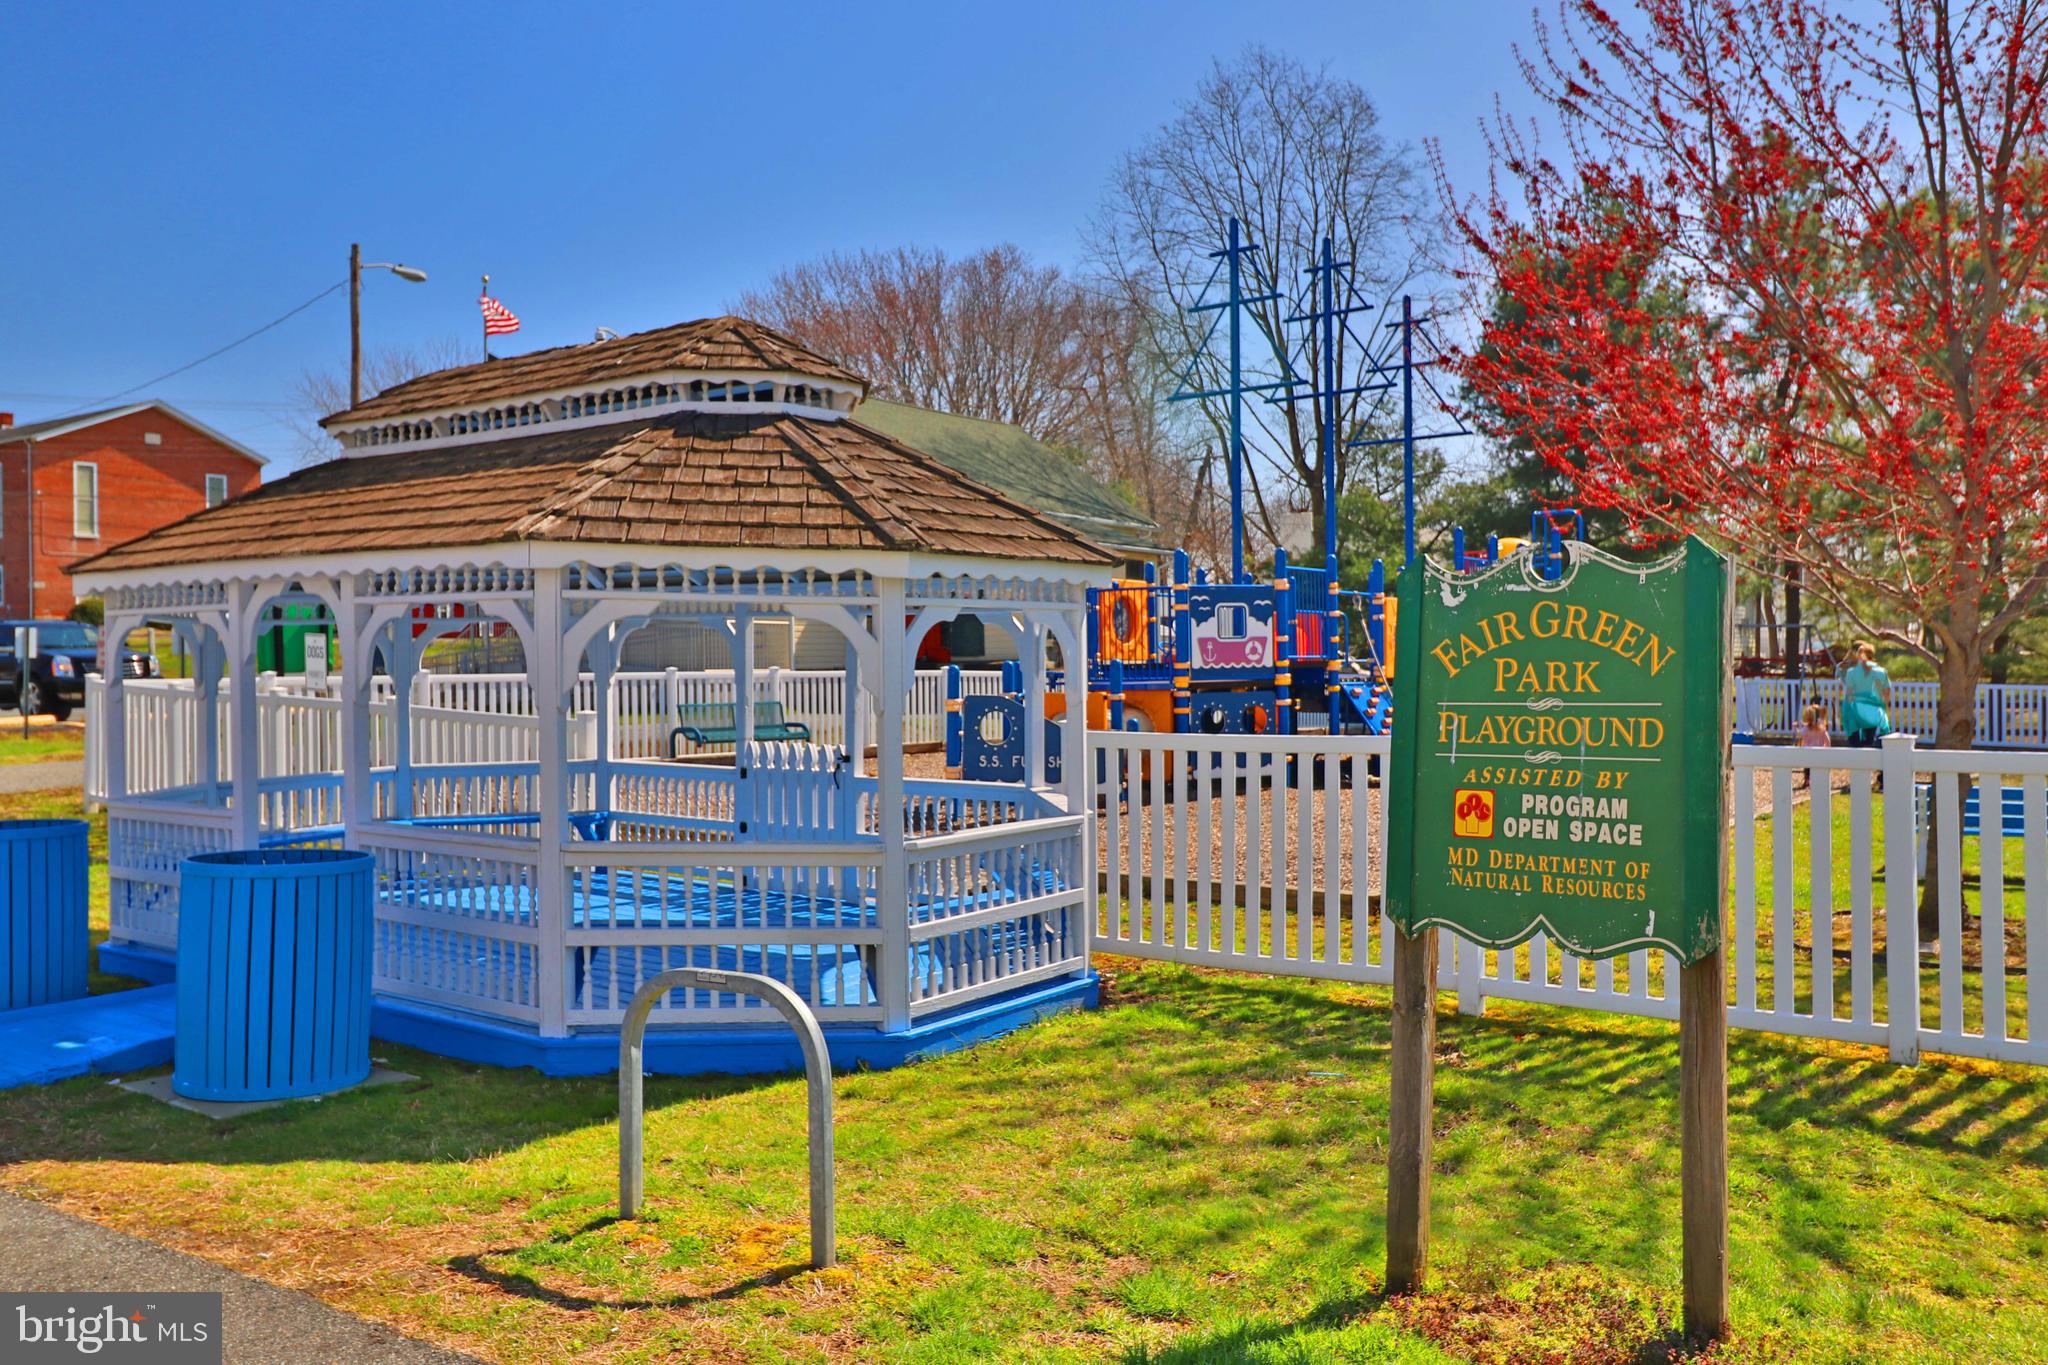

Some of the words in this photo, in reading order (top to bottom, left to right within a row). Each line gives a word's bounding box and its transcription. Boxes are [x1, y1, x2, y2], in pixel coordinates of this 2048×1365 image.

[1431, 609, 1526, 678] FAIR
[1529, 600, 1677, 677] GREEN
[1493, 657, 1601, 693] PARK
[1437, 711, 1664, 749] PLAYGROUND
[978, 755, 1004, 768] S.S.
[1463, 767, 1582, 788] ASSISTED
[1596, 771, 1630, 790] BY
[1521, 793, 1629, 820] PROGRAM
[1502, 816, 1560, 841] OPEN
[1569, 819, 1643, 846] SPACE
[1447, 846, 1479, 867] MD
[1489, 850, 1617, 877] DEPARTMENT
[1625, 860, 1651, 880] OF
[1450, 867, 1532, 892] NATURAL
[1541, 874, 1647, 902] RESOURCES
